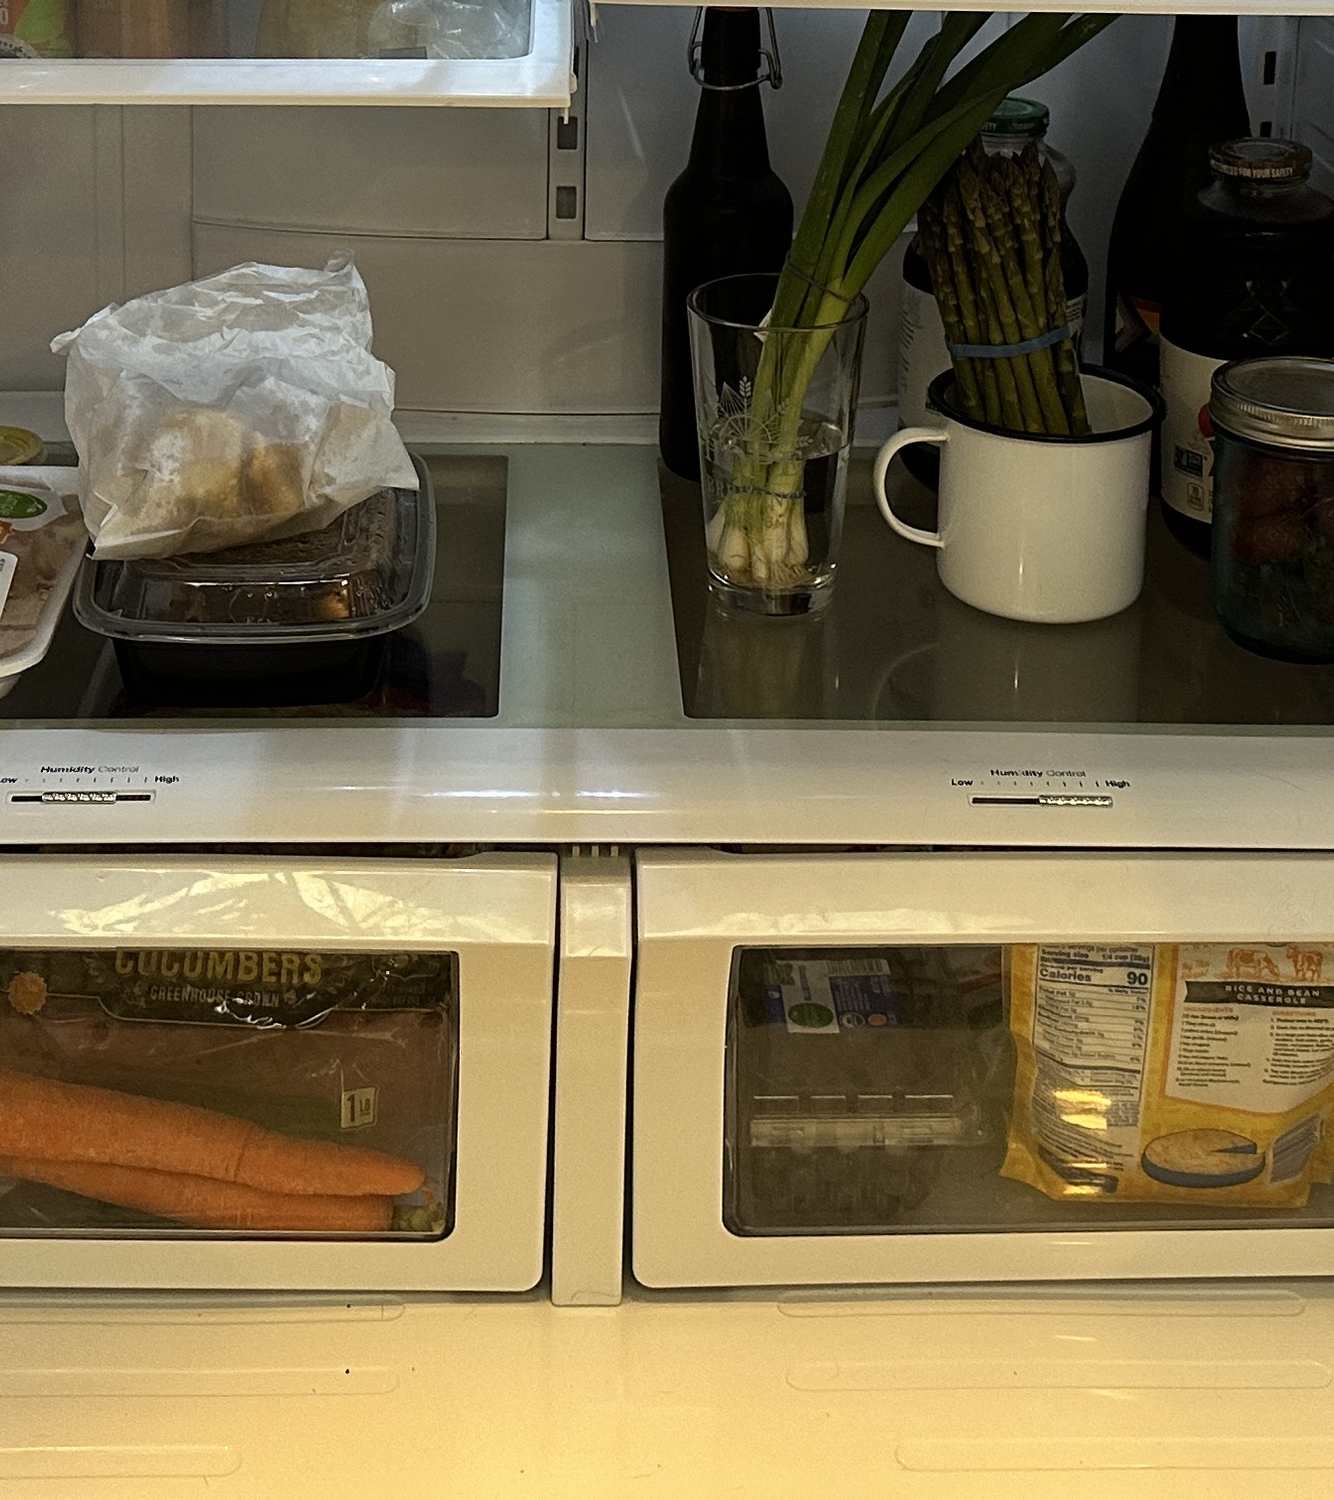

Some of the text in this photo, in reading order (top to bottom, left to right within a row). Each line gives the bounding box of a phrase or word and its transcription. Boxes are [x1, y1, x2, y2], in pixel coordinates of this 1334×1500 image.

[1252, 168, 1271, 178] YOUR
[1271, 166, 1293, 178] SAFETY
[40, 765, 95, 775] Humidity
[990, 769, 1087, 778] Humidity Control
[154, 775, 180, 784] High
[951, 778, 1130, 788] Low High
[1041, 948, 1071, 958] Serving
[116, 950, 324, 985] CUCUMBERS
[1039, 968, 1149, 986] Calories 90
[149, 985, 231, 1003] GREENHOUSE
[1225, 984, 1320, 997] RICE AND BEAN
[1237, 993, 1307, 1005] CASSEROLE
